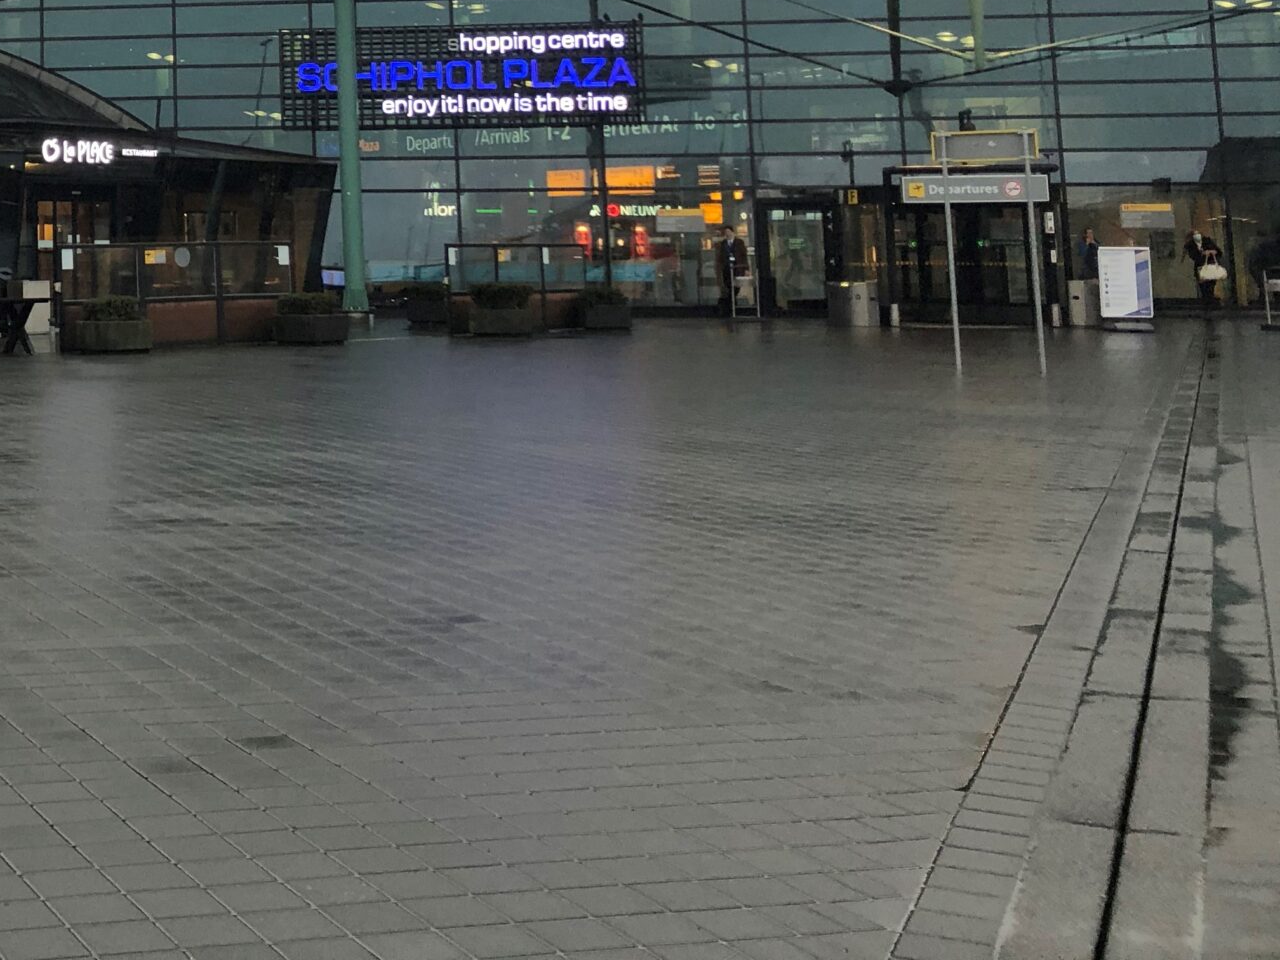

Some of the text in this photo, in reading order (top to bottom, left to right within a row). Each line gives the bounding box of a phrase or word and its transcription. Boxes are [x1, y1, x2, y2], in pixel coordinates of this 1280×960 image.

[448, 31, 625, 54] shopping centre
[503, 57, 637, 89] PLAZA
[382, 92, 628, 117] enjoy it! now is the time
[77, 140, 114, 164] PLACE
